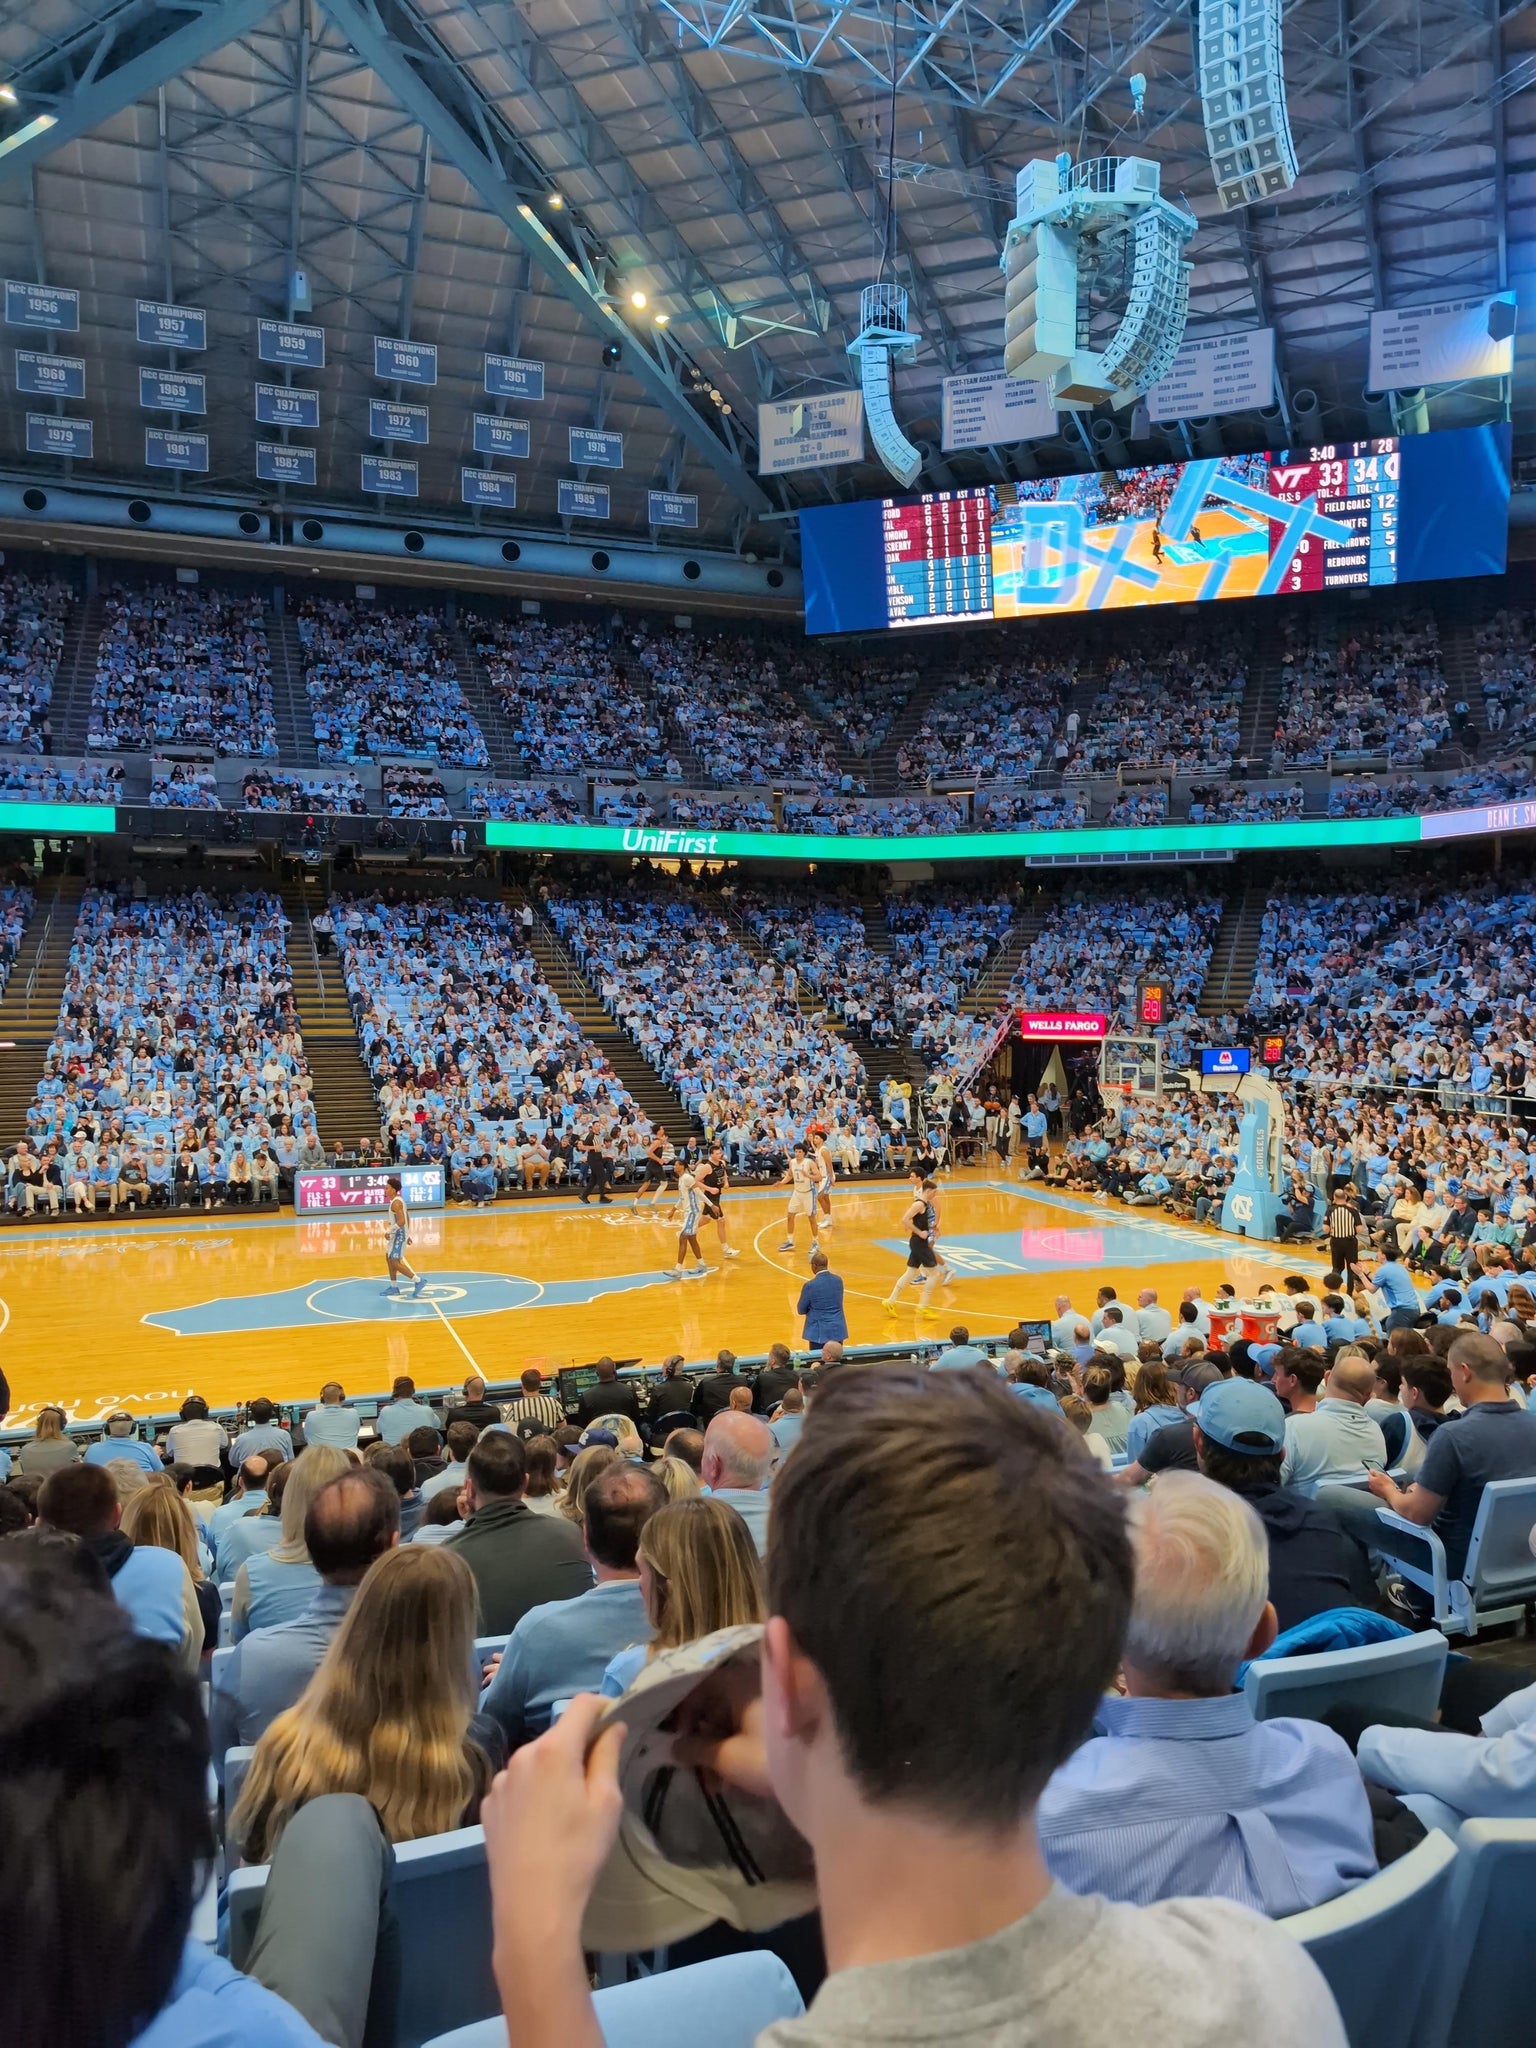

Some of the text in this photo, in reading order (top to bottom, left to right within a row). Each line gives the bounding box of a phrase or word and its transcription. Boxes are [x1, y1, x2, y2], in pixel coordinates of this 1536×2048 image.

[8, 284, 76, 301] ACC CHAMPIONS
[29, 299, 58, 313] 1956
[140, 304, 203, 320] ACC CHAMPIONS
[160, 319, 186, 332] 1957
[261, 322, 322, 338] ACC CHAMPIONS
[279, 336, 306, 350] 1959
[378, 340, 434, 356] ACC CHAMPIONS
[20, 354, 82, 369] ACC CHAMPIONS
[394, 353, 419, 367] 1960
[488, 357, 542, 372] ACC CHAMPIONS
[38, 368, 66, 380] 1968
[142, 370, 202, 385] ACC CHAMPIONS
[504, 370, 526, 383] 1961
[160, 384, 186, 396] 1969
[259, 386, 315, 401] ACC CHAMPIONS
[277, 399, 299, 411] 1971
[373, 402, 426, 416] ACC CHAMPIONS
[30, 416, 90, 430] ACC CHAMPIONS
[388, 415, 410, 427] 1972
[476, 416, 528, 430] ACC CHAMPIONS
[48, 430, 73, 441] 1979
[149, 431, 205, 445] ACC CHAMPIONS
[491, 429, 512, 441] 1975
[572, 430, 621, 443] ACC CHAMPIONS
[167, 443, 190, 455] 1981
[259, 444, 313, 458] ACC CHAMPIONS
[588, 441, 606, 453] 1976
[1310, 445, 1335, 461] 3:40
[1378, 439, 1393, 453] 28
[274, 456, 299, 468] 1982
[364, 458, 416, 471] ACC CHAMPIONS
[379, 470, 402, 481] 1983
[464, 470, 513, 483] ACC CHAMPIONS
[1272, 457, 1378, 489] VT 33 34
[479, 482, 500, 493] 1984
[560, 482, 608, 495] ACC CHAMPIONS
[1317, 488, 1340, 498] TOL: 4
[1357, 483, 1380, 493] TOL: 4
[574, 493, 595, 504] 1985
[663, 495, 696, 504] CHAMPIONS
[922, 494, 933, 503] PTS
[939, 492, 950, 501] REB
[957, 490, 968, 498] AST
[975, 488, 985, 496] FLS
[1295, 492, 1300, 501] 6
[664, 503, 683, 514] 1987
[883, 498, 984, 519] FORD 2 2 1 0
[1324, 502, 1345, 512] FIELD
[1346, 499, 1370, 510] GOALS
[926, 526, 932, 537] 4
[944, 525, 948, 535] 1
[961, 523, 967, 533] 4
[979, 521, 984, 531] 1
[926, 538, 932, 548] 4
[944, 536, 949, 546] 1
[961, 534, 967, 544] 0
[978, 532, 984, 542] 3
[1342, 536, 1370, 548] HROWS
[1292, 559, 1302, 572] 9
[1327, 555, 1366, 568] REBOUNDS
[1292, 573, 1368, 590] 3 TURNOVERS
[929, 592, 935, 603] 2
[946, 591, 952, 601] 2
[964, 589, 970, 599] 0
[980, 587, 987, 597] 2
[888, 598, 987, 617] AVAC 2 2 1 0
[1488, 808, 1509, 828] DEAN
[622, 829, 718, 854] UniFirst
[1143, 1000, 1160, 1020] 28
[1028, 1021, 1099, 1031] WELLS FARGO
[300, 1179, 317, 1188] VT
[322, 1177, 336, 1189] 33
[405, 1174, 418, 1185] 34
[340, 1191, 363, 1203] VT
[1225, 1322, 1234, 1332] G
[1264, 1323, 1275, 1334] G
[94, 1389, 194, 1404] novo
